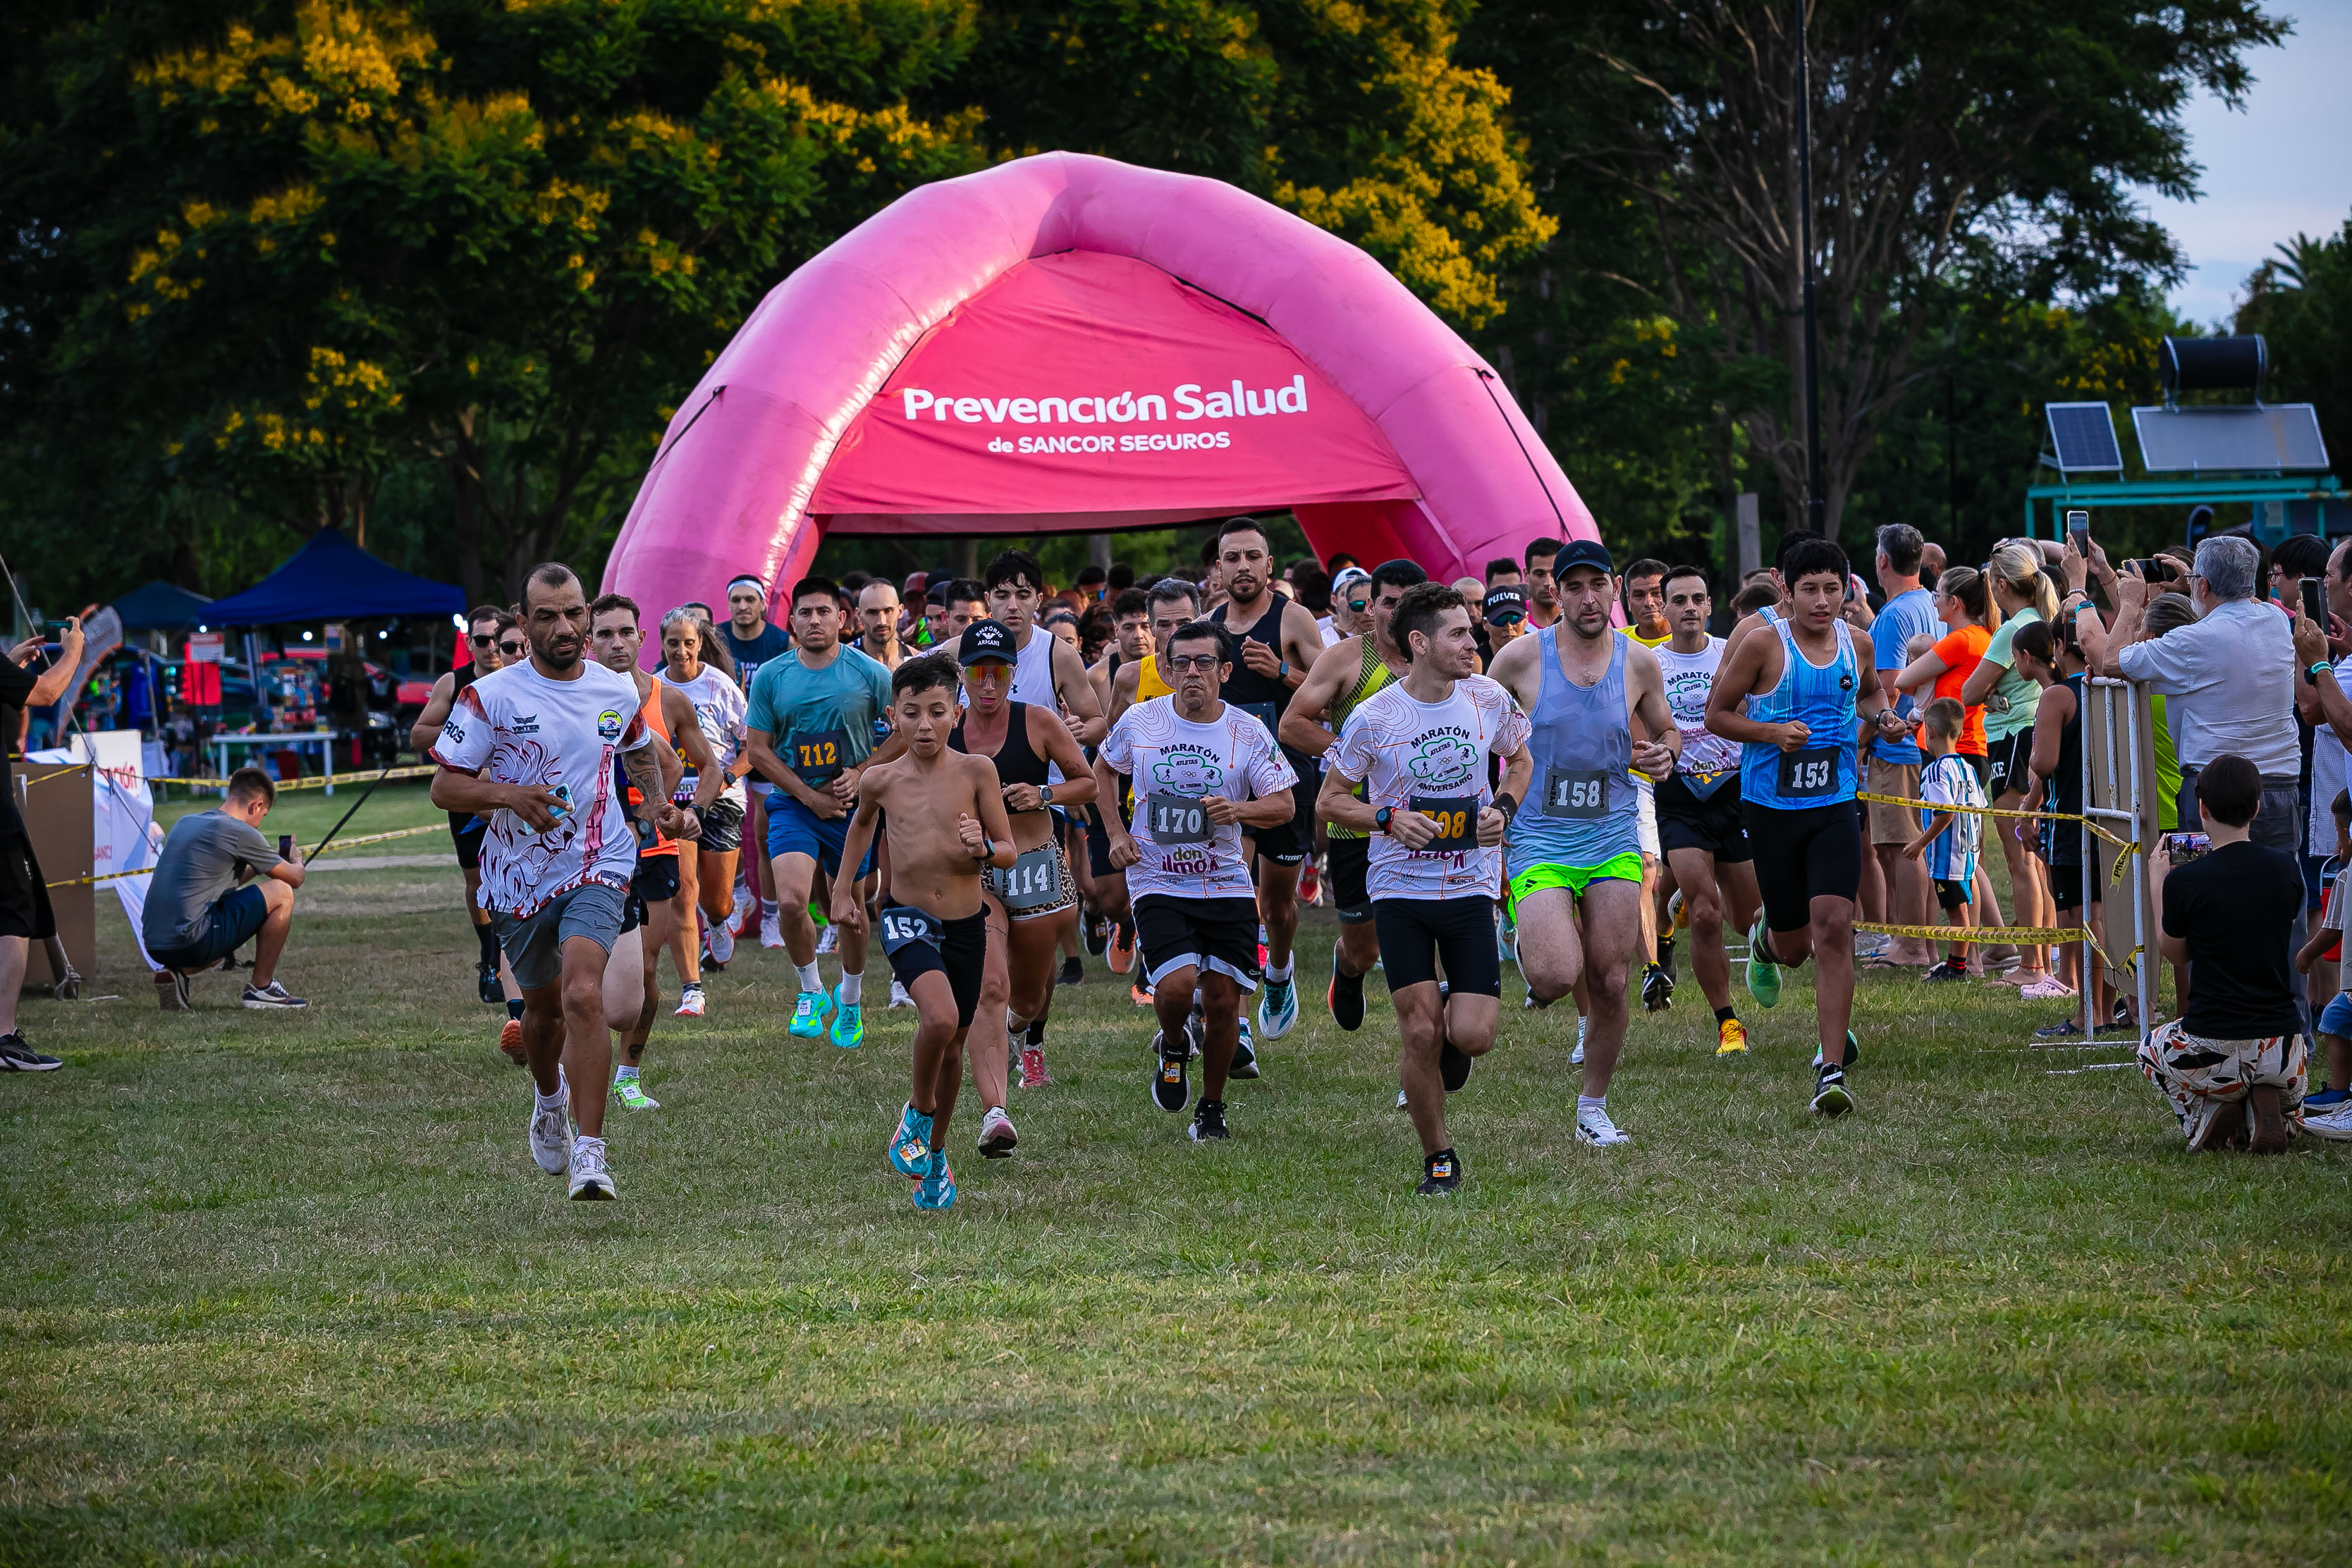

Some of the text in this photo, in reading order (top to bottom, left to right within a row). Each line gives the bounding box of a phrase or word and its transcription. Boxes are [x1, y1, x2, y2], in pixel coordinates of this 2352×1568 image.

[903, 374, 1307, 424] Prevención Salud
[988, 431, 1230, 453] de SANCOR SEGUROS
[1488, 592, 1521, 606] PULVER
[1672, 712, 1705, 723] ANIVERS
[1410, 725, 1471, 749] MARATÓN
[800, 742, 837, 766] 712
[1159, 742, 1221, 764] MARATÓN
[1430, 741, 1451, 757] ATLETAS
[1416, 773, 1474, 792] ANIVERSARIO
[1792, 760, 1829, 788] 153
[1557, 780, 1600, 807] 158
[1158, 807, 1201, 833] 170
[1161, 854, 1208, 875] ilmo
[1172, 846, 1202, 862] don
[1008, 864, 1048, 896] 114
[883, 915, 928, 941] 152
